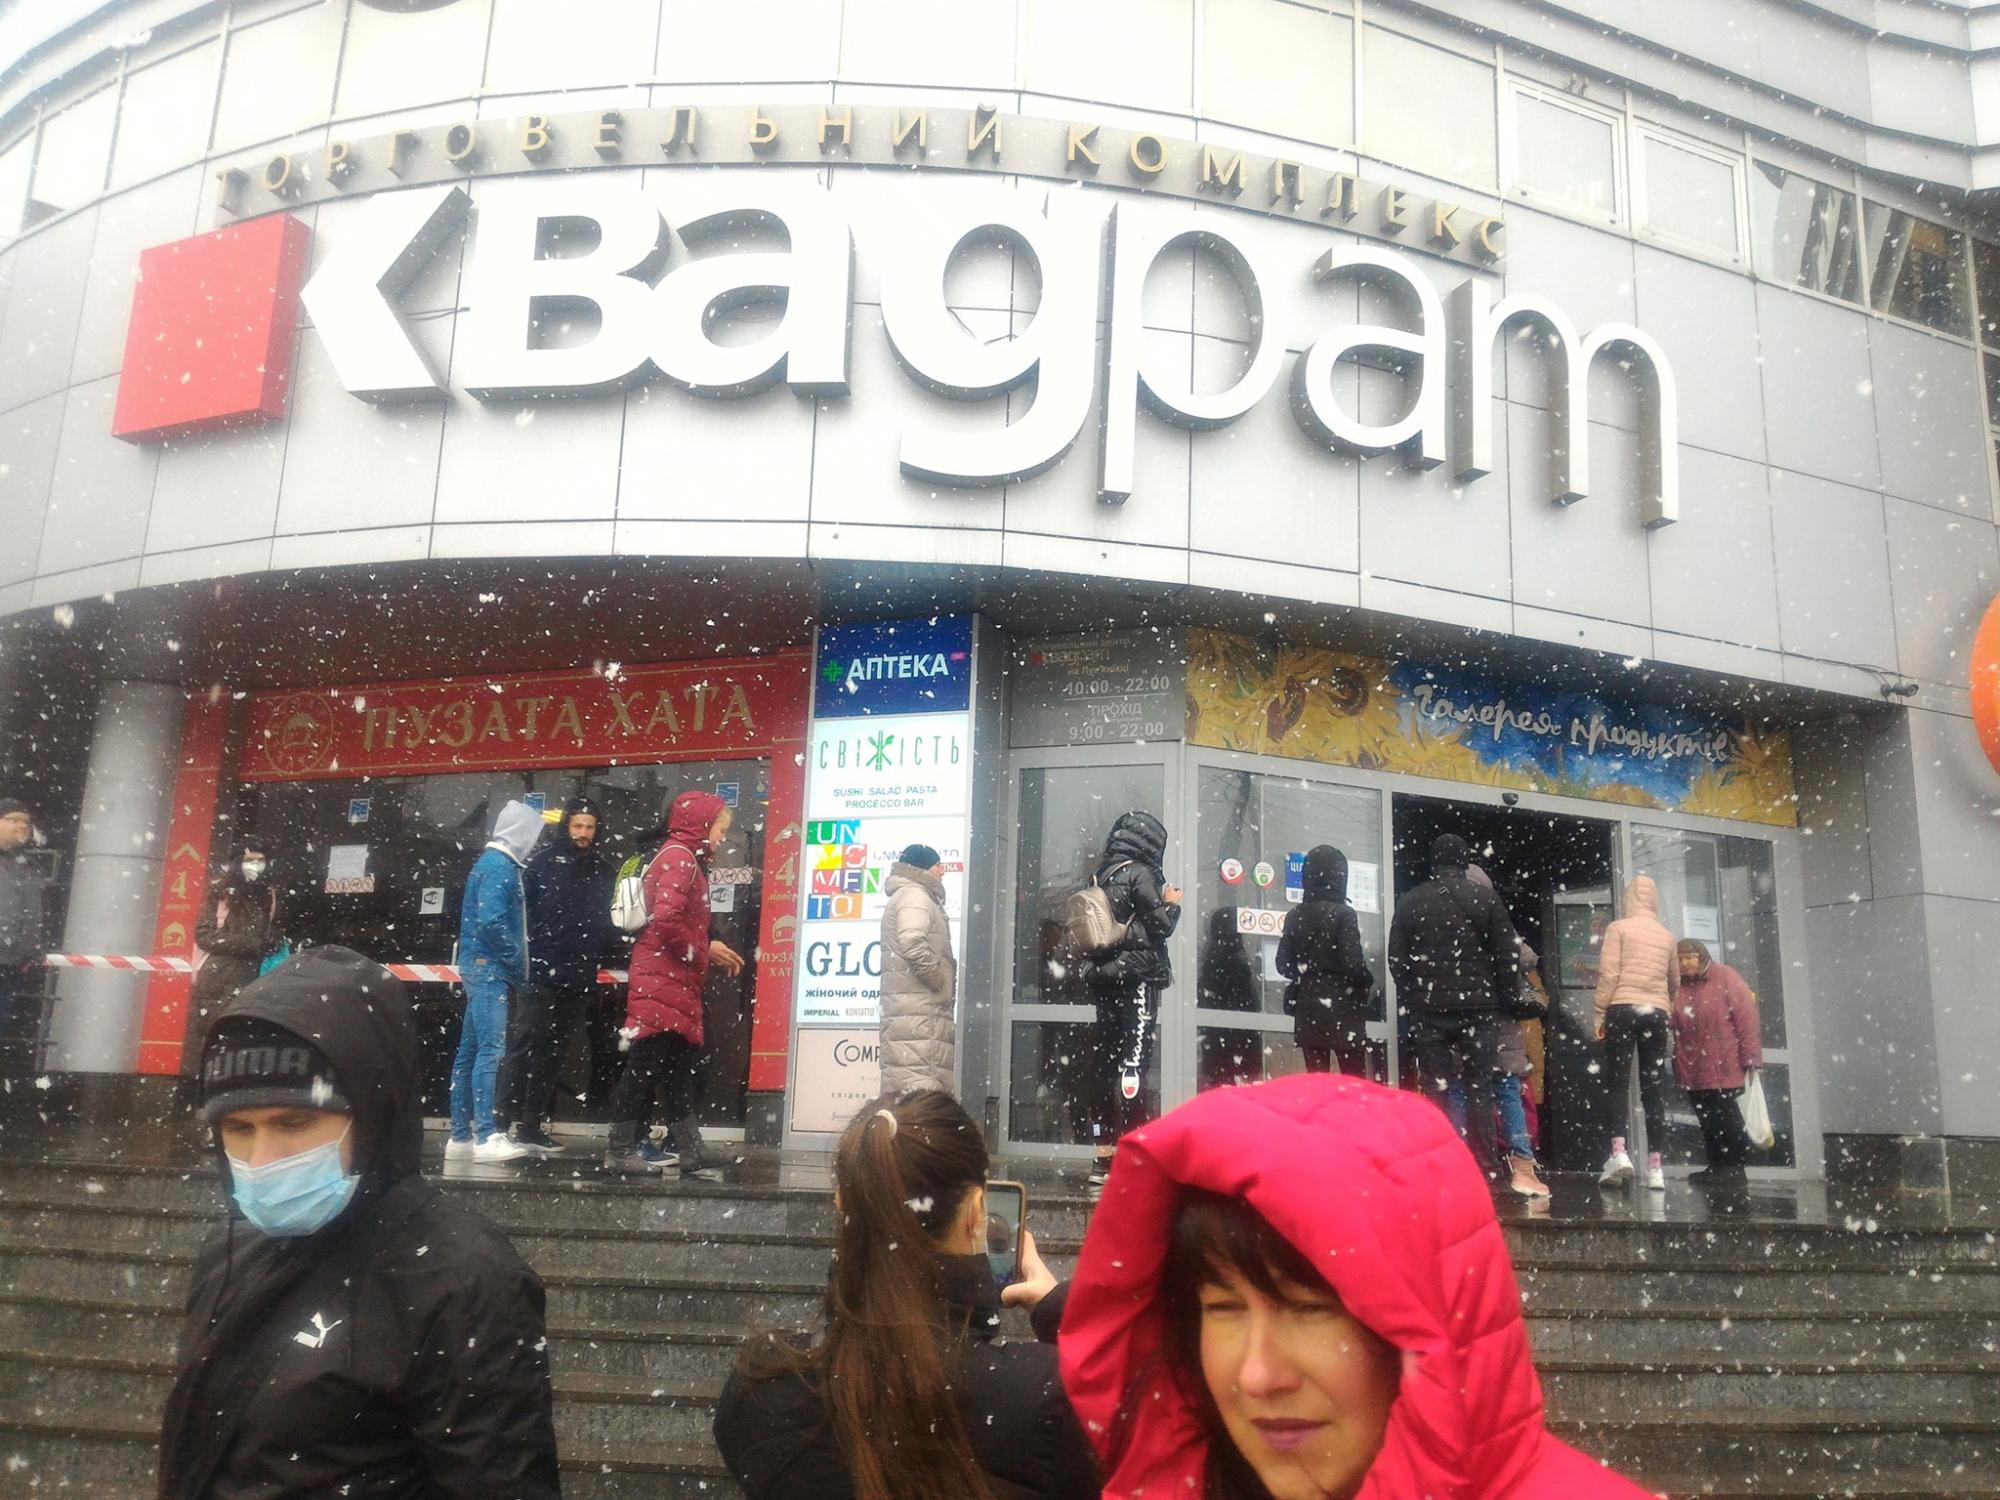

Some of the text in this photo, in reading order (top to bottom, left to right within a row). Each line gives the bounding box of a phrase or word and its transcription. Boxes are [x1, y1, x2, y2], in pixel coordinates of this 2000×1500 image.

[216, 104, 1505, 262] ТОРГОВЕЛЬНИЙ КОМПЛЕКС
[847, 653, 950, 681] АПТЕКА
[1066, 680, 1110, 696] 10:00
[1125, 676, 1171, 692] 22:00
[362, 695, 585, 752] ПУЗАТА
[605, 684, 756, 735] ХАТА
[1090, 702, 1144, 716] ПРОХІД
[1068, 726, 1104, 740] 9:00
[1119, 721, 1165, 738] 22:00
[819, 730, 960, 771] СВІЖІСТЬ
[833, 785, 938, 797] SUSHI SALAD PASTA
[845, 798, 925, 809] PROCECCO BAR
[775, 855, 795, 886] 4
[170, 870, 187, 898] 4
[762, 951, 794, 963] ПУЗА
[806, 941, 881, 977] GLO
[769, 967, 793, 977] ХАТ
[805, 987, 858, 998] жіночий
[804, 1009, 840, 1017] IMPERIAL
[1118, 981, 1151, 1099] Champio
[834, 1038, 880, 1067] COMP
